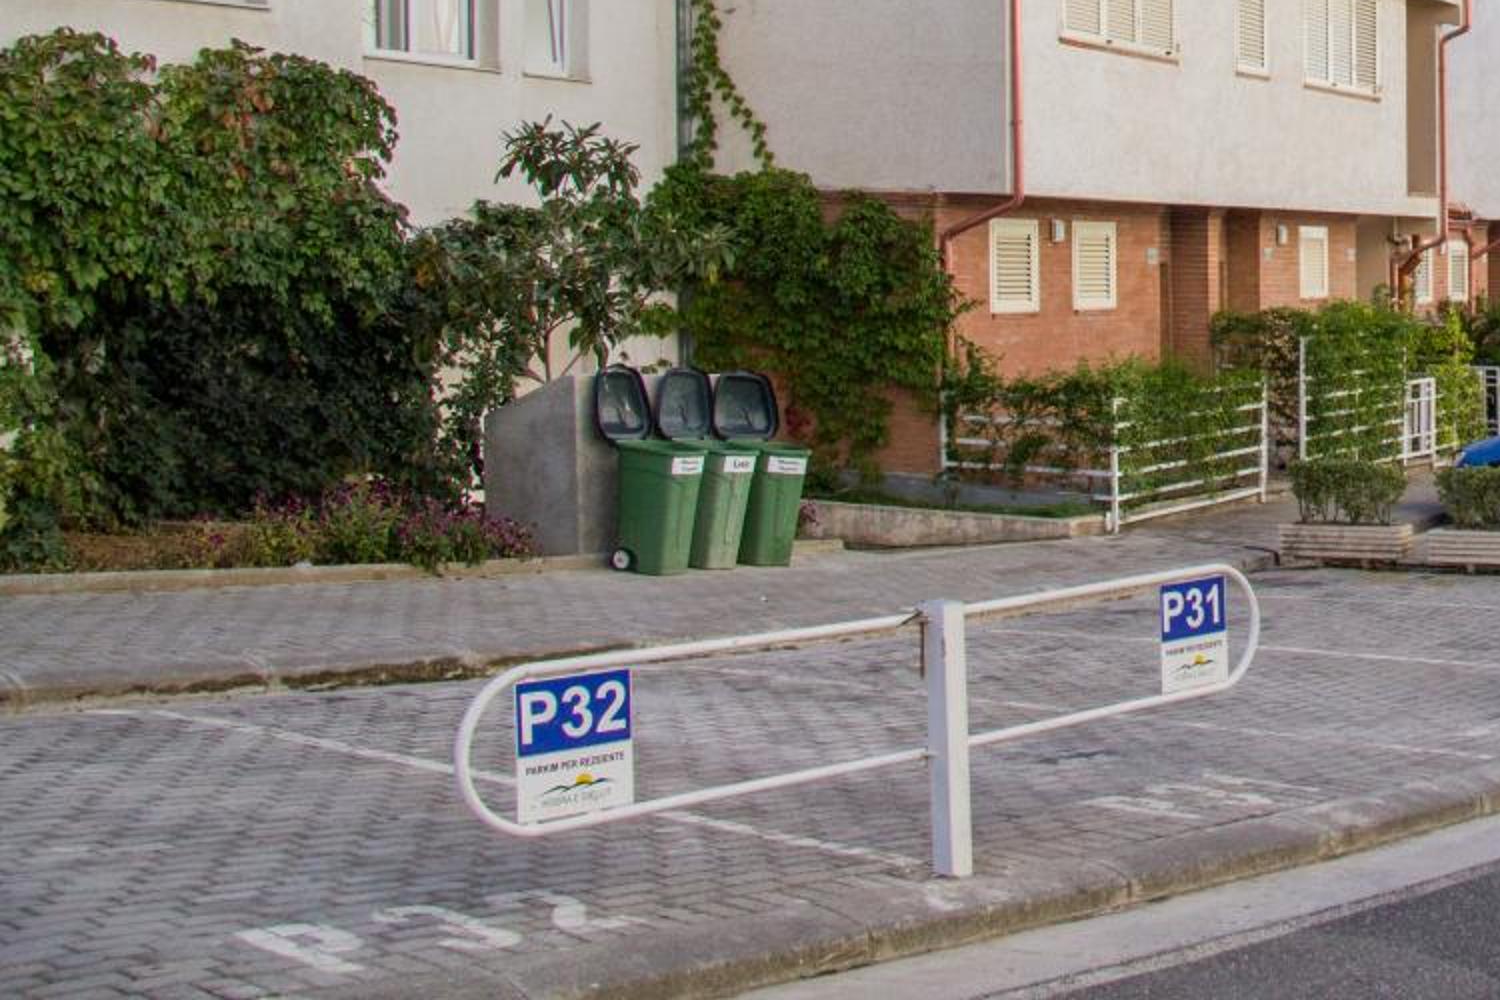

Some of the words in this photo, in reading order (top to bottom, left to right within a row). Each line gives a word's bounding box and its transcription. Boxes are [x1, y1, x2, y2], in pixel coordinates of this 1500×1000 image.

[1162, 583, 1220, 633] P31
[519, 679, 628, 745] P32
[229, 889, 650, 972] P32
